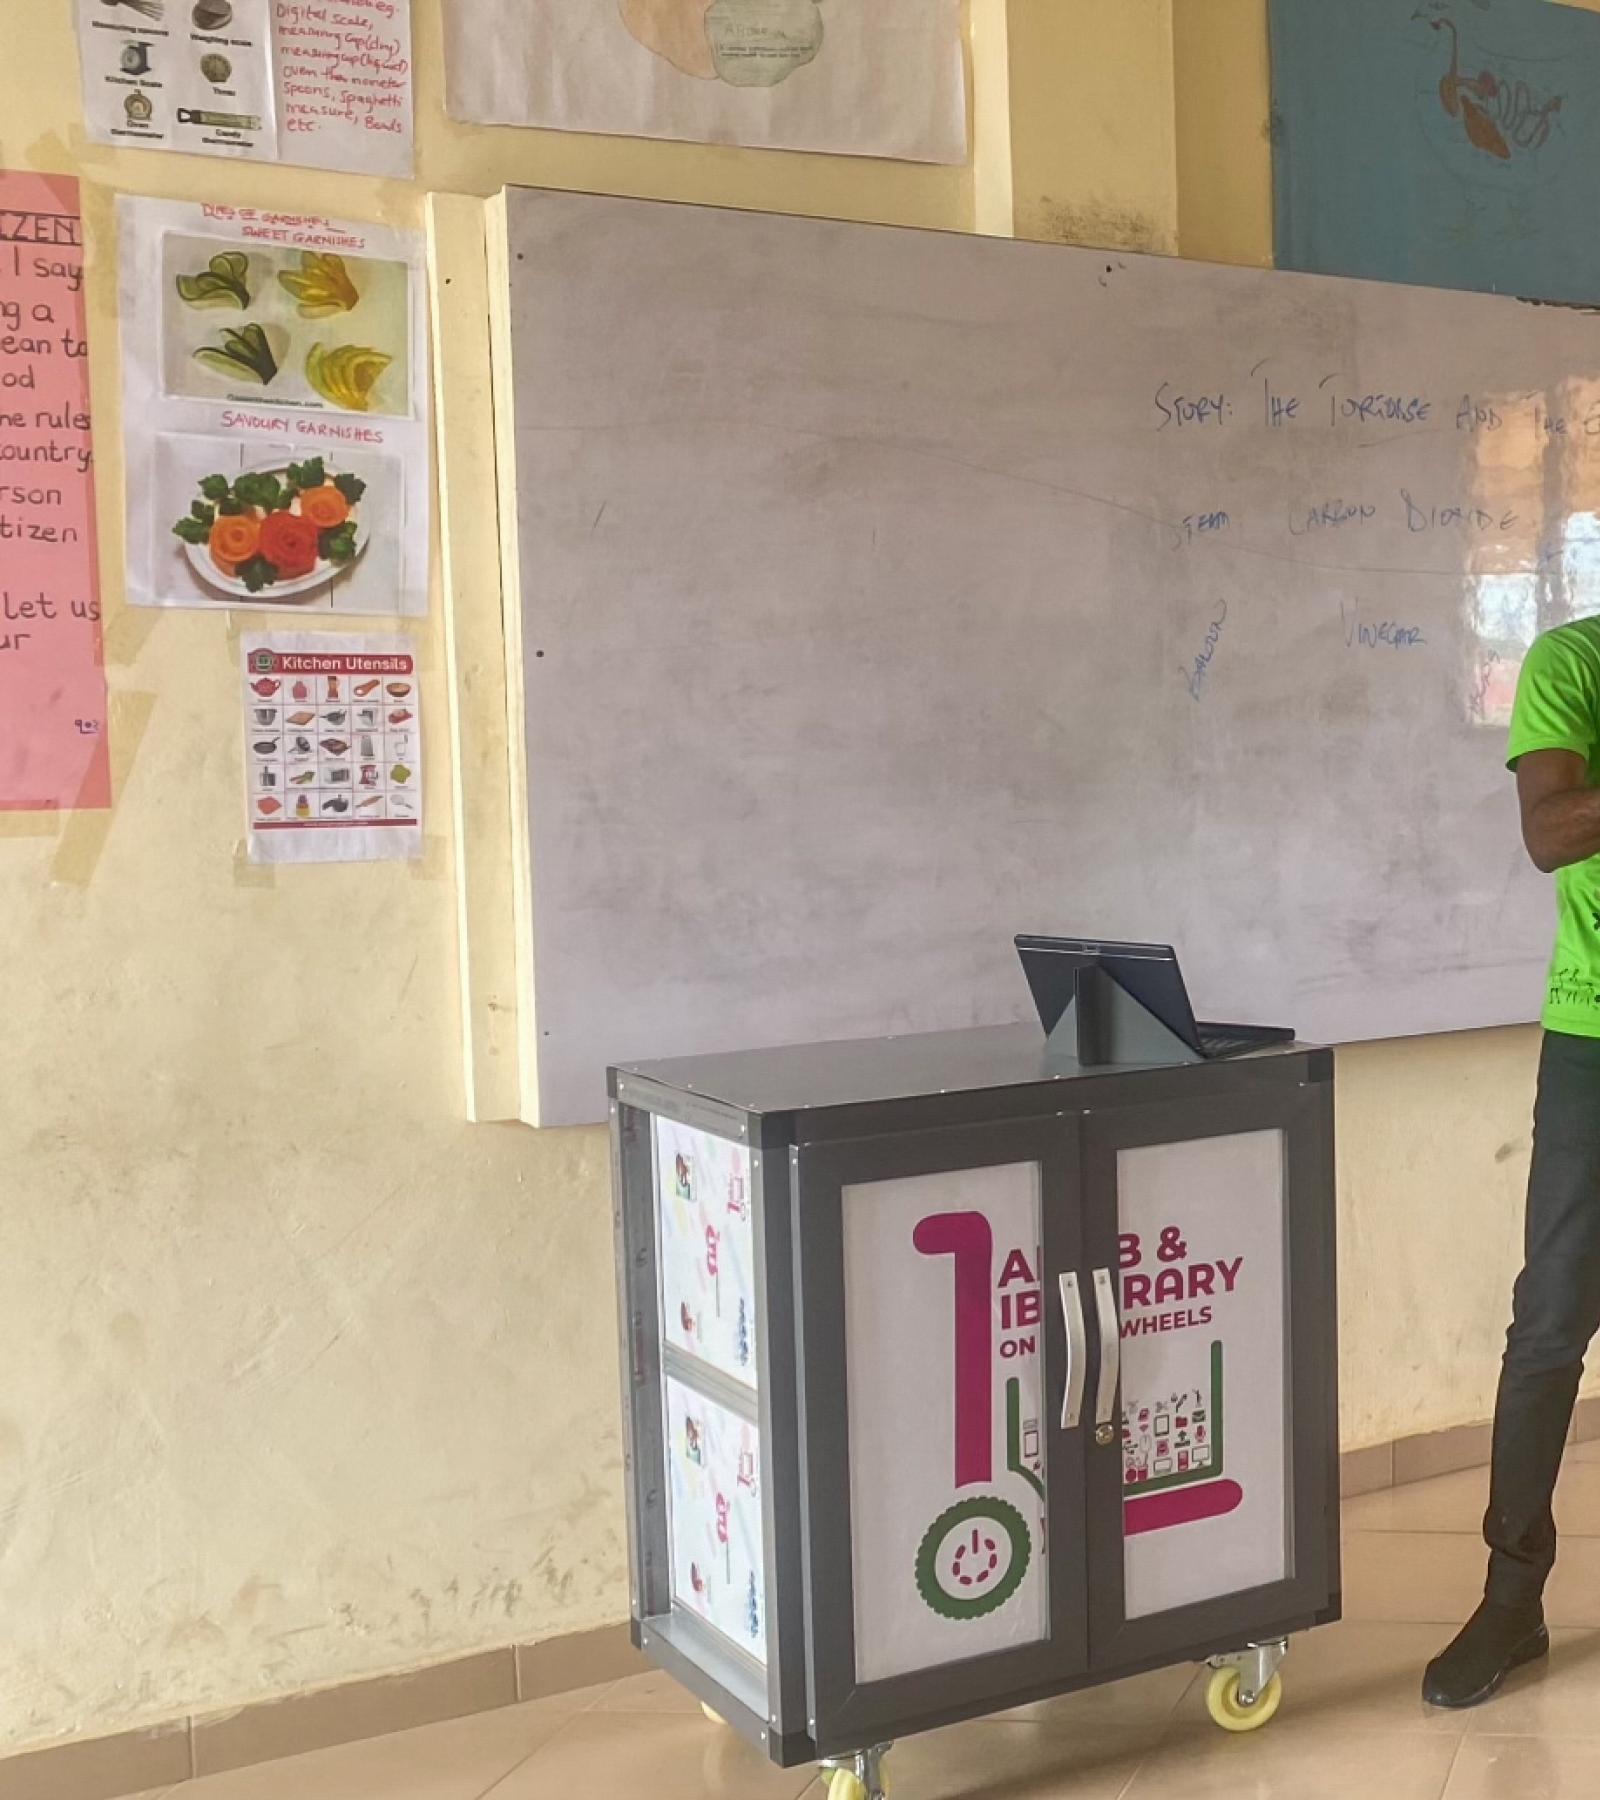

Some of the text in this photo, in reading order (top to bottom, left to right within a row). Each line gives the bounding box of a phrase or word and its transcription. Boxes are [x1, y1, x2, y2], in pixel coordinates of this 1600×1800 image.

[32, 303, 54, 323] a
[221, 410, 384, 444] SAVOURY GARNISHES
[0, 440, 93, 474] ountry.
[3, 592, 99, 621] let us
[281, 655, 407, 671] Kitchen Utensils
[1156, 1226, 1188, 1263] &
[999, 1305, 1213, 1359] ON WHEELS
